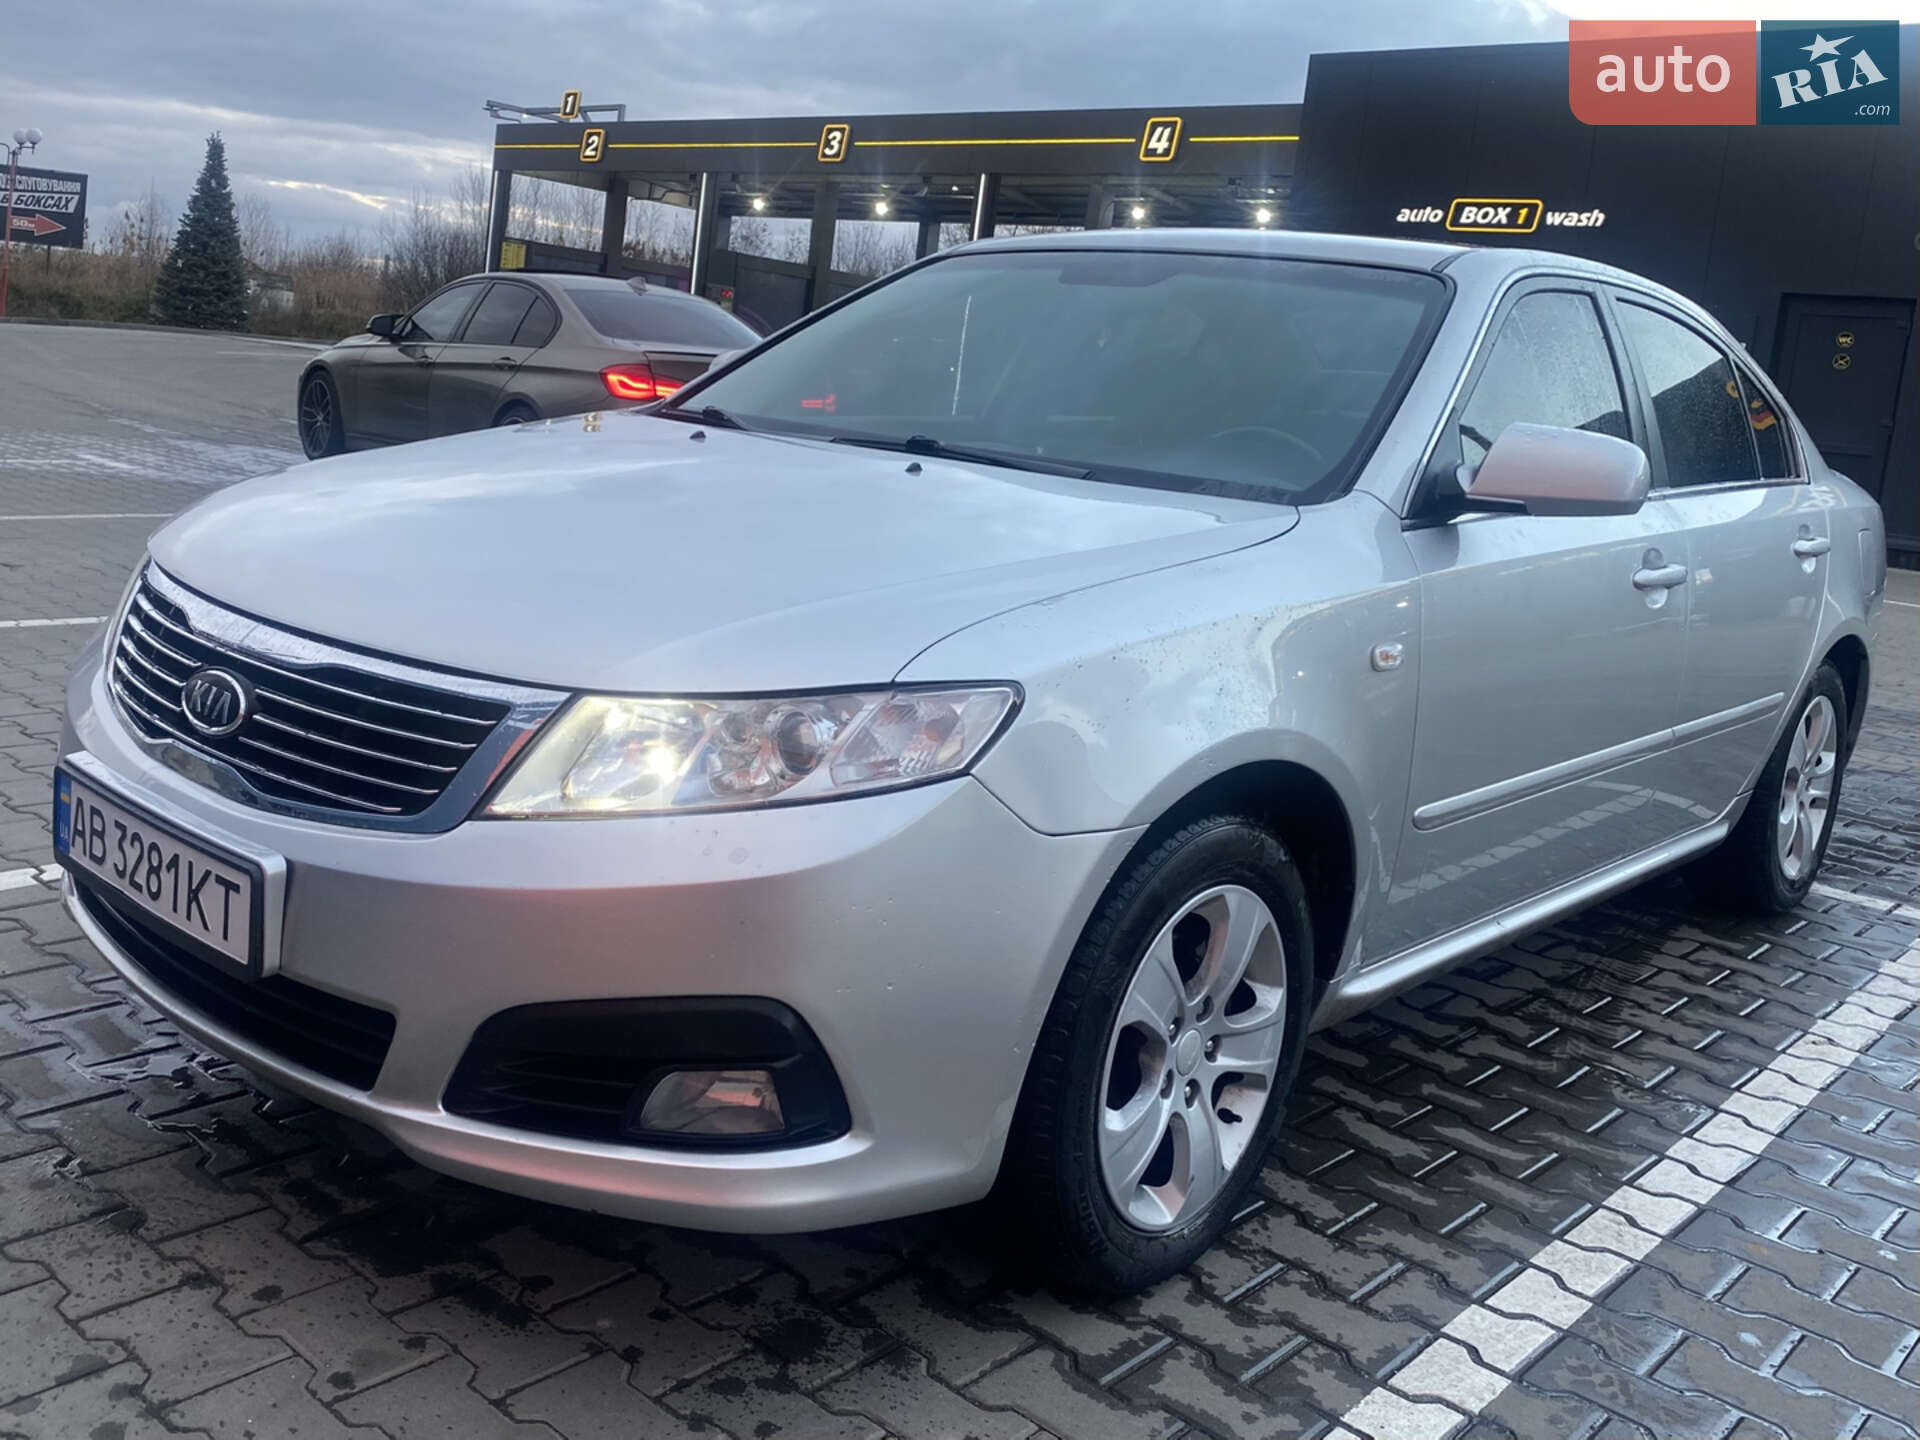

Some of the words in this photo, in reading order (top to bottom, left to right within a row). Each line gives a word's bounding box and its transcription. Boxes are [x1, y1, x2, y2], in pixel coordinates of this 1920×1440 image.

[565, 95, 575, 113] 1
[583, 135, 599, 157] 2
[823, 130, 843, 156] 3
[1147, 126, 1172, 155] 4
[14, 194, 75, 212] БОКСАХ
[1396, 206, 1444, 223] auto
[1459, 206, 1511, 225] BOX
[1516, 207, 1529, 225] 1
[1545, 209, 1605, 228] wash
